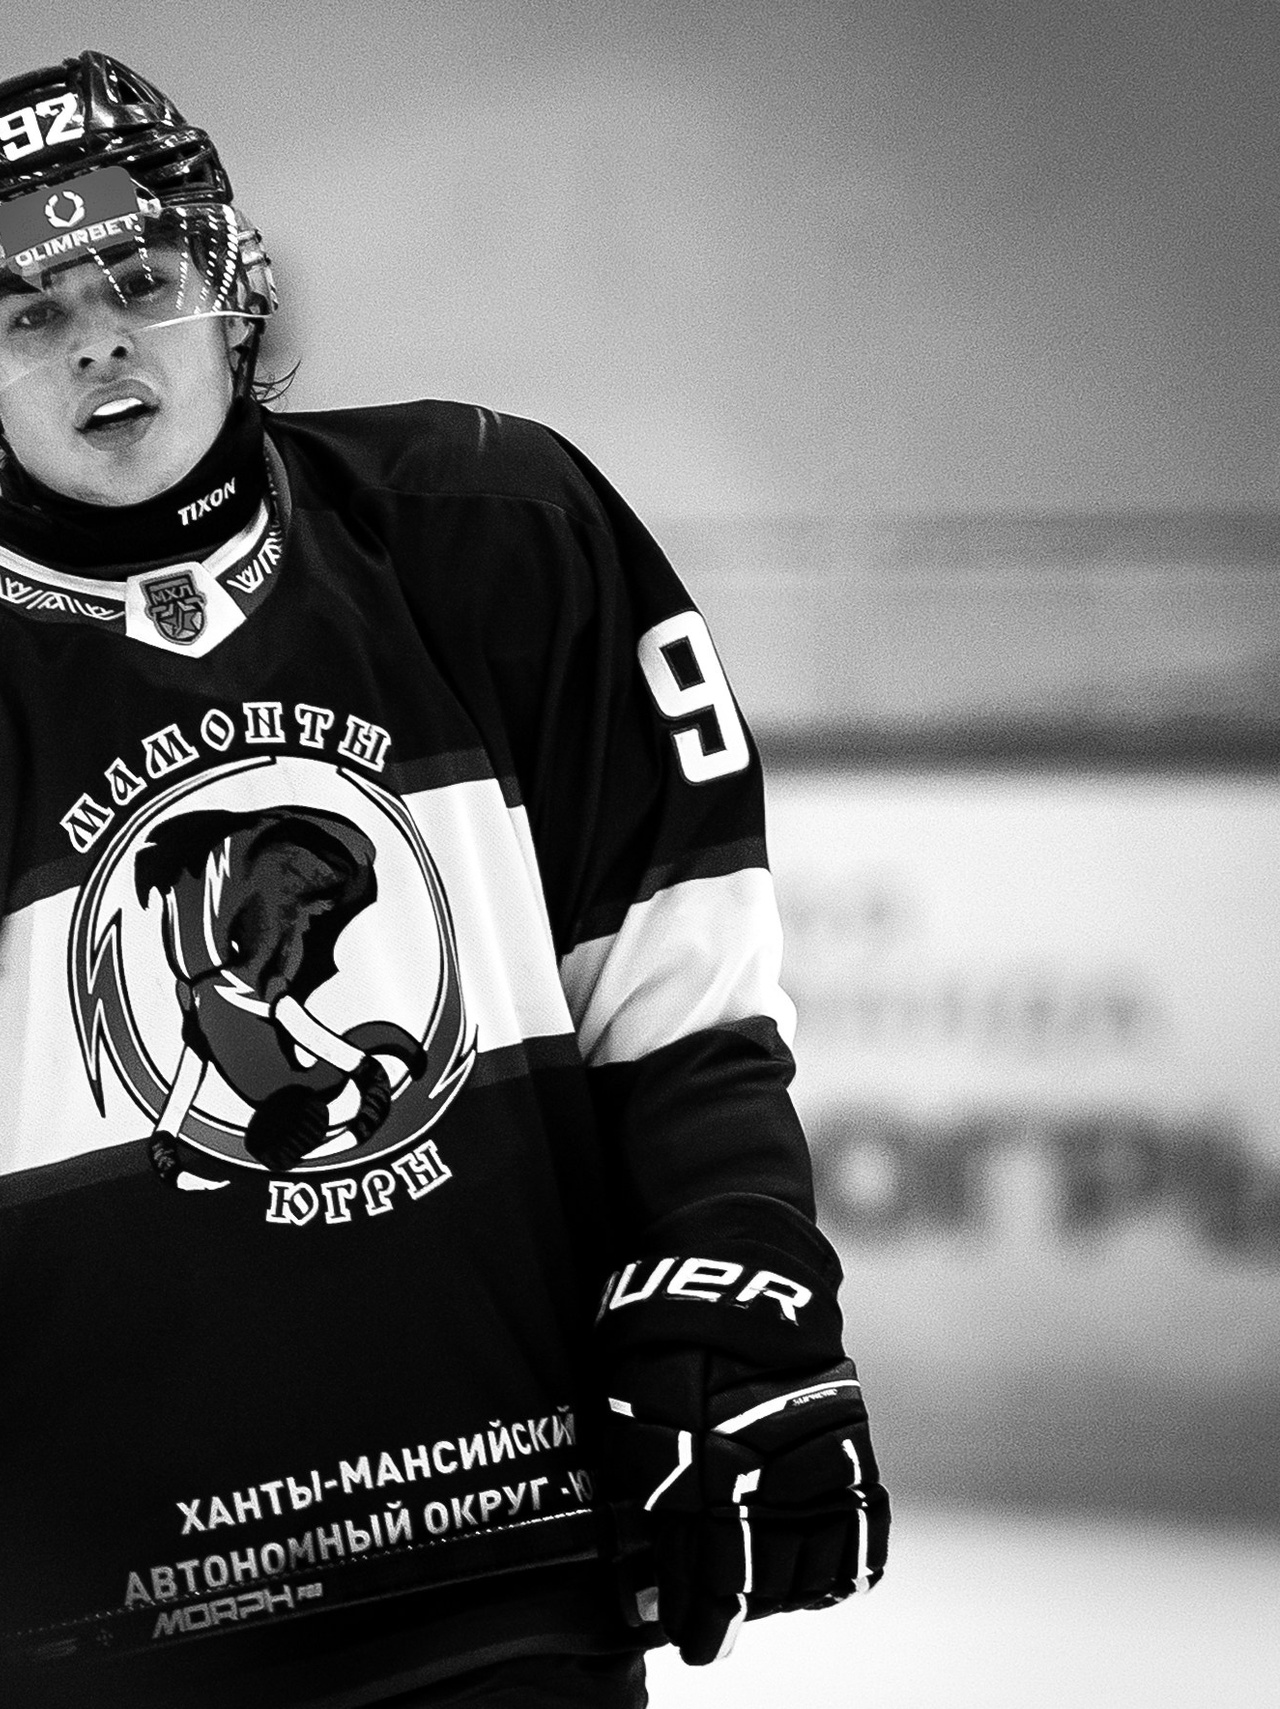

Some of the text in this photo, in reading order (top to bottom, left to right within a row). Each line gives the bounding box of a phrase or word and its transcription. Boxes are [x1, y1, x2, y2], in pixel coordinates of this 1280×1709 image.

[177, 476, 236, 527] TIXON
[150, 584, 194, 606] МХЛ
[636, 609, 751, 785] 9
[123, 1500, 414, 1606] АВТОНОМНЫЙ
[423, 1476, 550, 1536] ОКРУГ
[151, 1584, 295, 1639] MORPH
